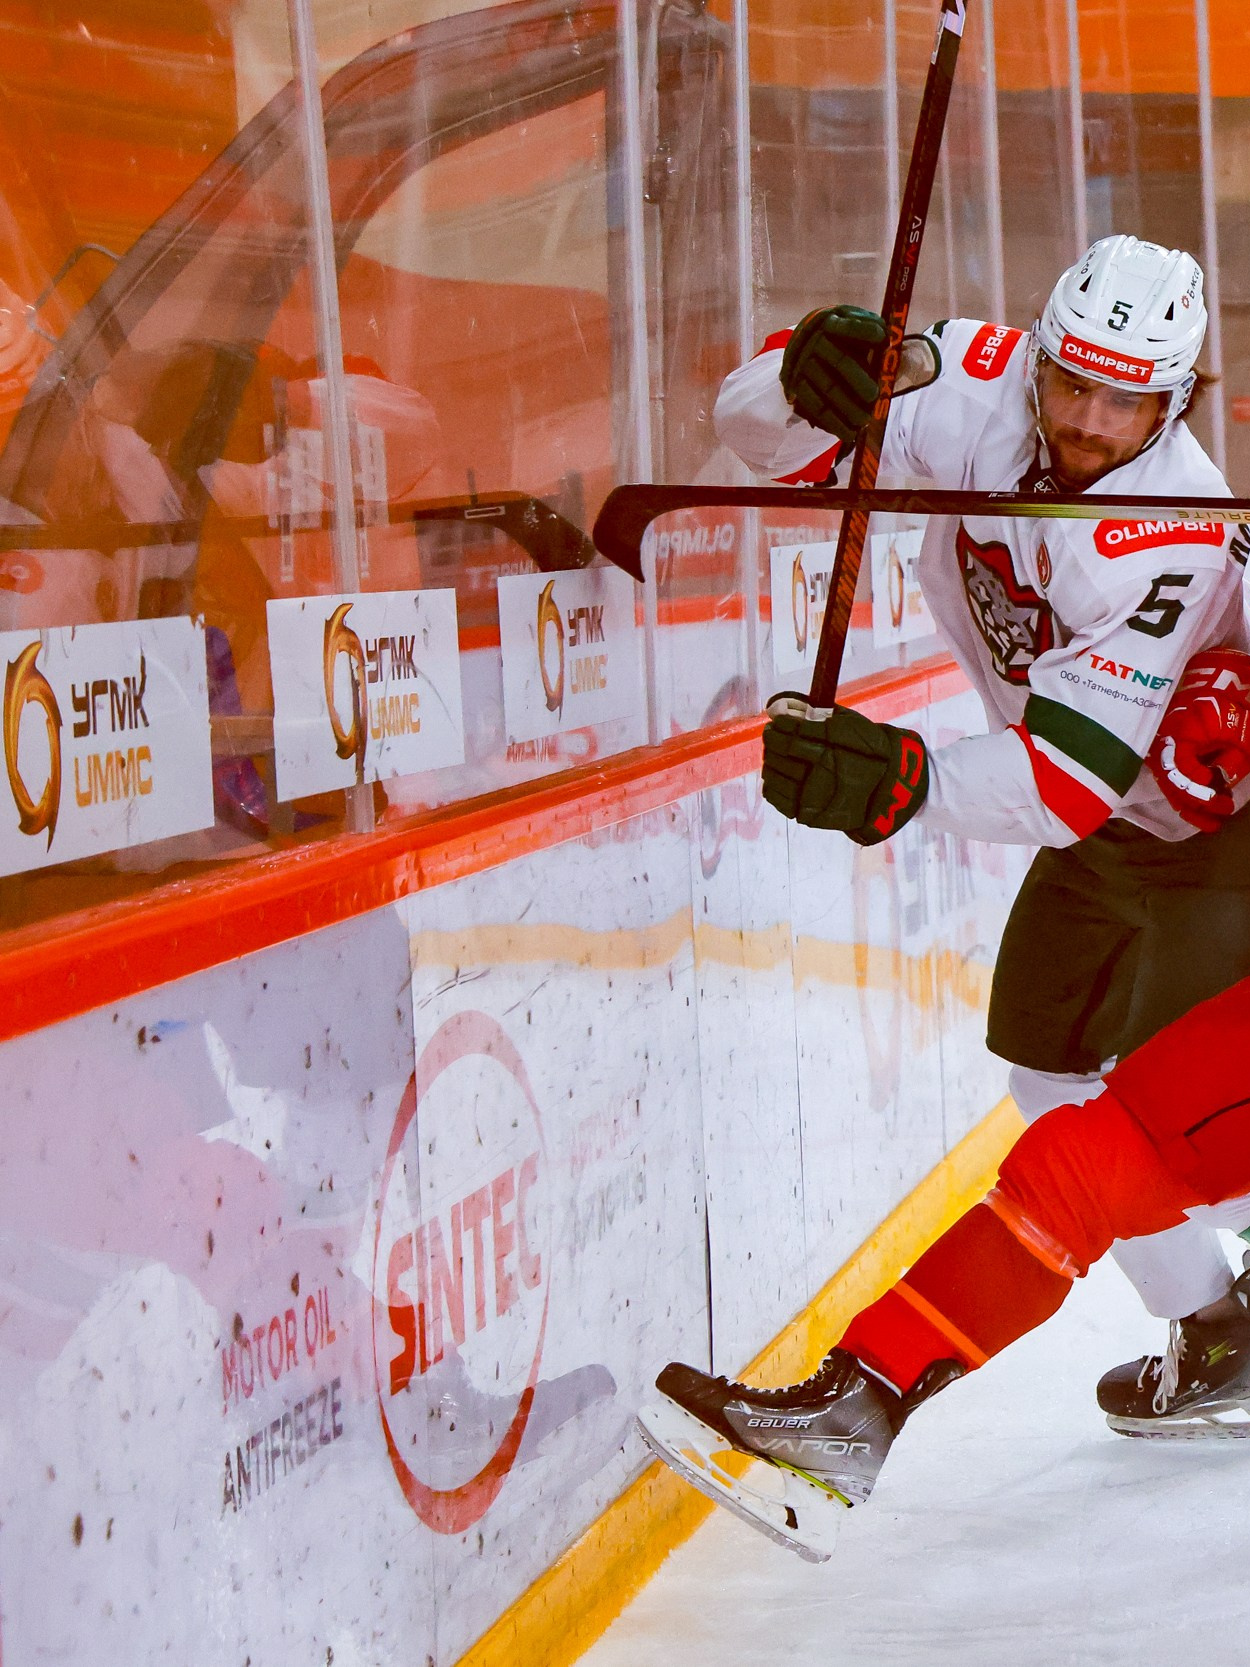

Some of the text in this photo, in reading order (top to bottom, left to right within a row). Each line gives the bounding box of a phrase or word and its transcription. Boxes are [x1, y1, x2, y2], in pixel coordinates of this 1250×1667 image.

[900, 266, 910, 291] PRO
[1107, 301, 1133, 331] 5
[873, 303, 908, 420] TACKS
[976, 325, 1010, 371] PBET
[1065, 343, 1150, 377] OLIMPBET
[567, 605, 605, 647] УГМК
[1126, 574, 1194, 639] 5
[365, 635, 418, 684] УГМК
[570, 654, 608, 694] UMMC
[1060, 670, 1080, 684] ООО
[71, 677, 150, 738] УГМК
[370, 692, 421, 741] UMMC
[74, 746, 152, 807] UMMC
[873, 730, 924, 836] CM
[388, 1152, 543, 1396] SINTEC
[221, 1287, 337, 1416] MOTOR OIL
[222, 1378, 343, 1516] ANTIFREEZE
[747, 1417, 810, 1430] BAUER
[754, 1437, 872, 1456] VAPOR
